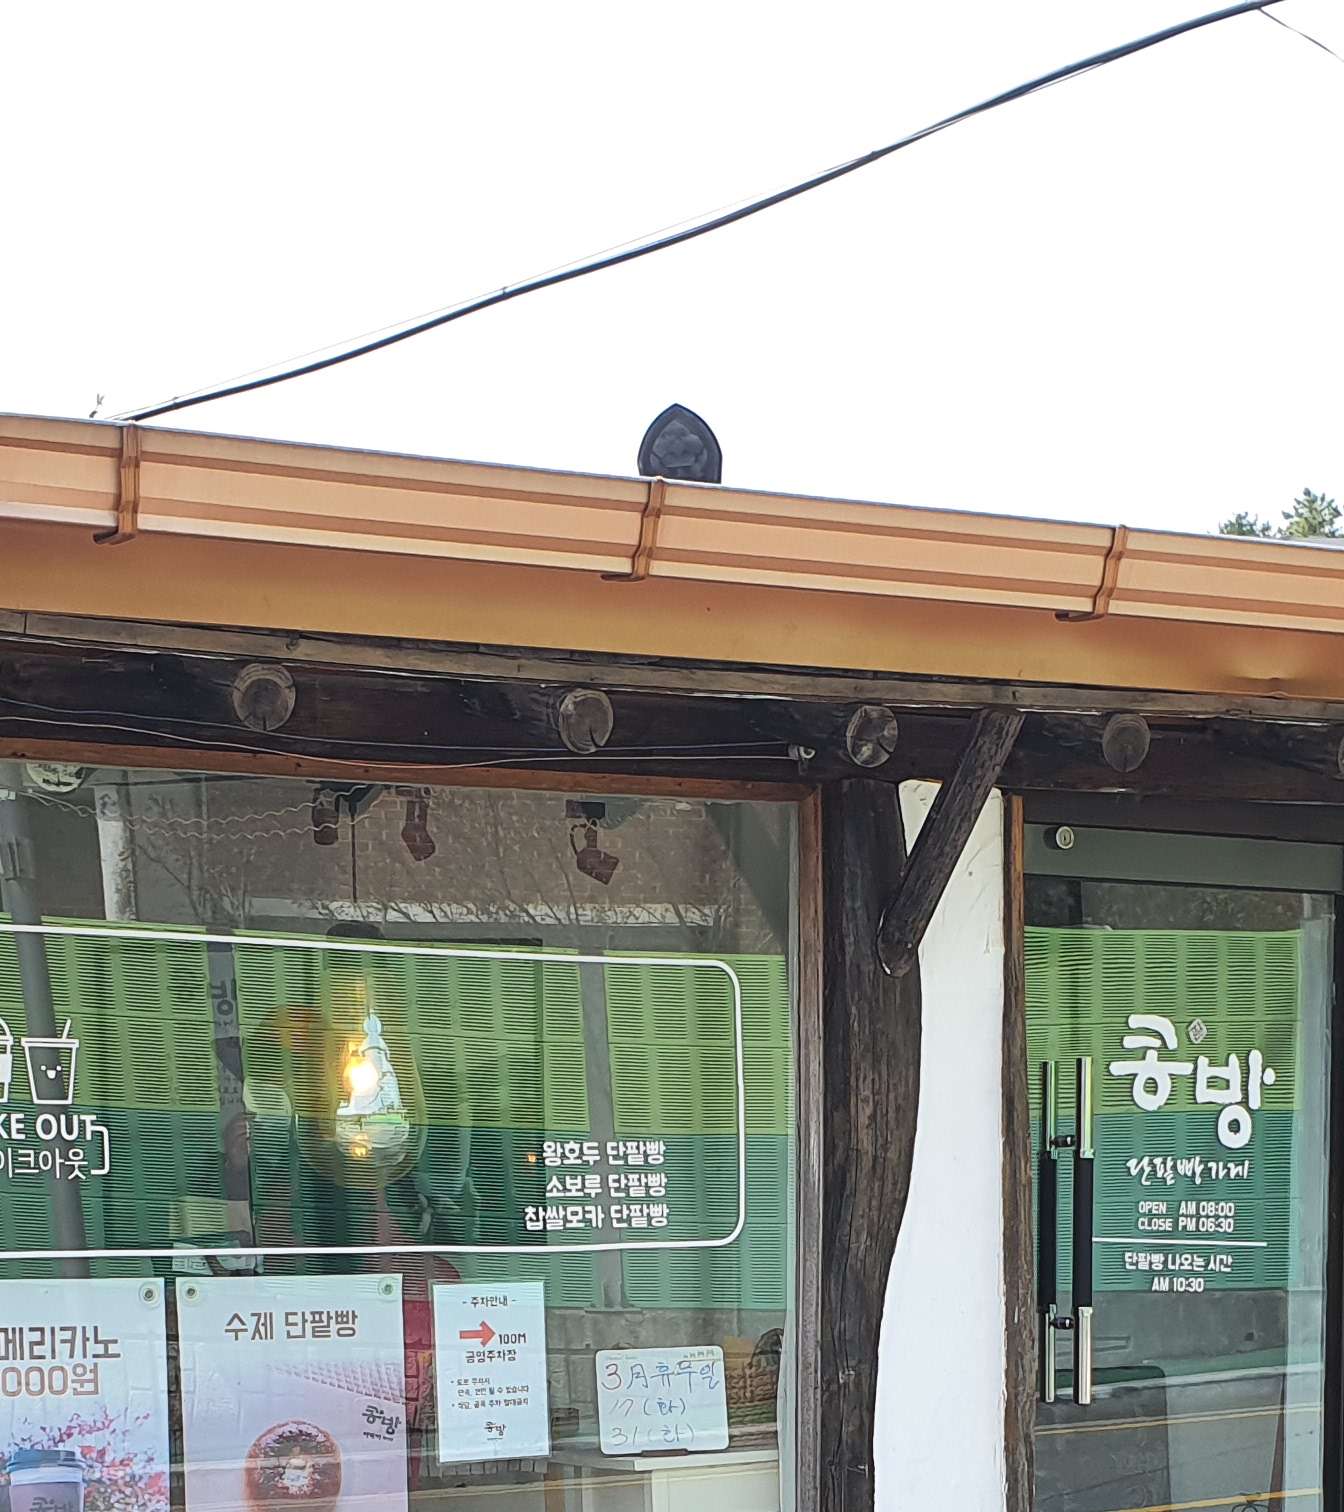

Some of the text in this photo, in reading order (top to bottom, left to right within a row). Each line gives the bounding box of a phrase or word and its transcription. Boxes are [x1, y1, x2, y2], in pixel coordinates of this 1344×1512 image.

[1108, 1013, 1276, 1149] 콩방
[36, 1113, 98, 1141] OUT
[542, 1140, 666, 1166] 왕호두 단팥빵
[545, 1173, 668, 1199] 소보루 단팥빵
[523, 1204, 670, 1231] 찹쌀모카 단팥빵
[1138, 1201, 1235, 1217] OPEN AM 08:00
[1137, 1217, 1234, 1233] CLOSE PM 06:30
[1167, 1254, 1205, 1272] 나오는
[1207, 1255, 1233, 1272] 시간
[1151, 1278, 1204, 1292] AM 10:30
[224, 1309, 359, 1341] 수제 단팥빵
[362, 1405, 402, 1435] 콩방
